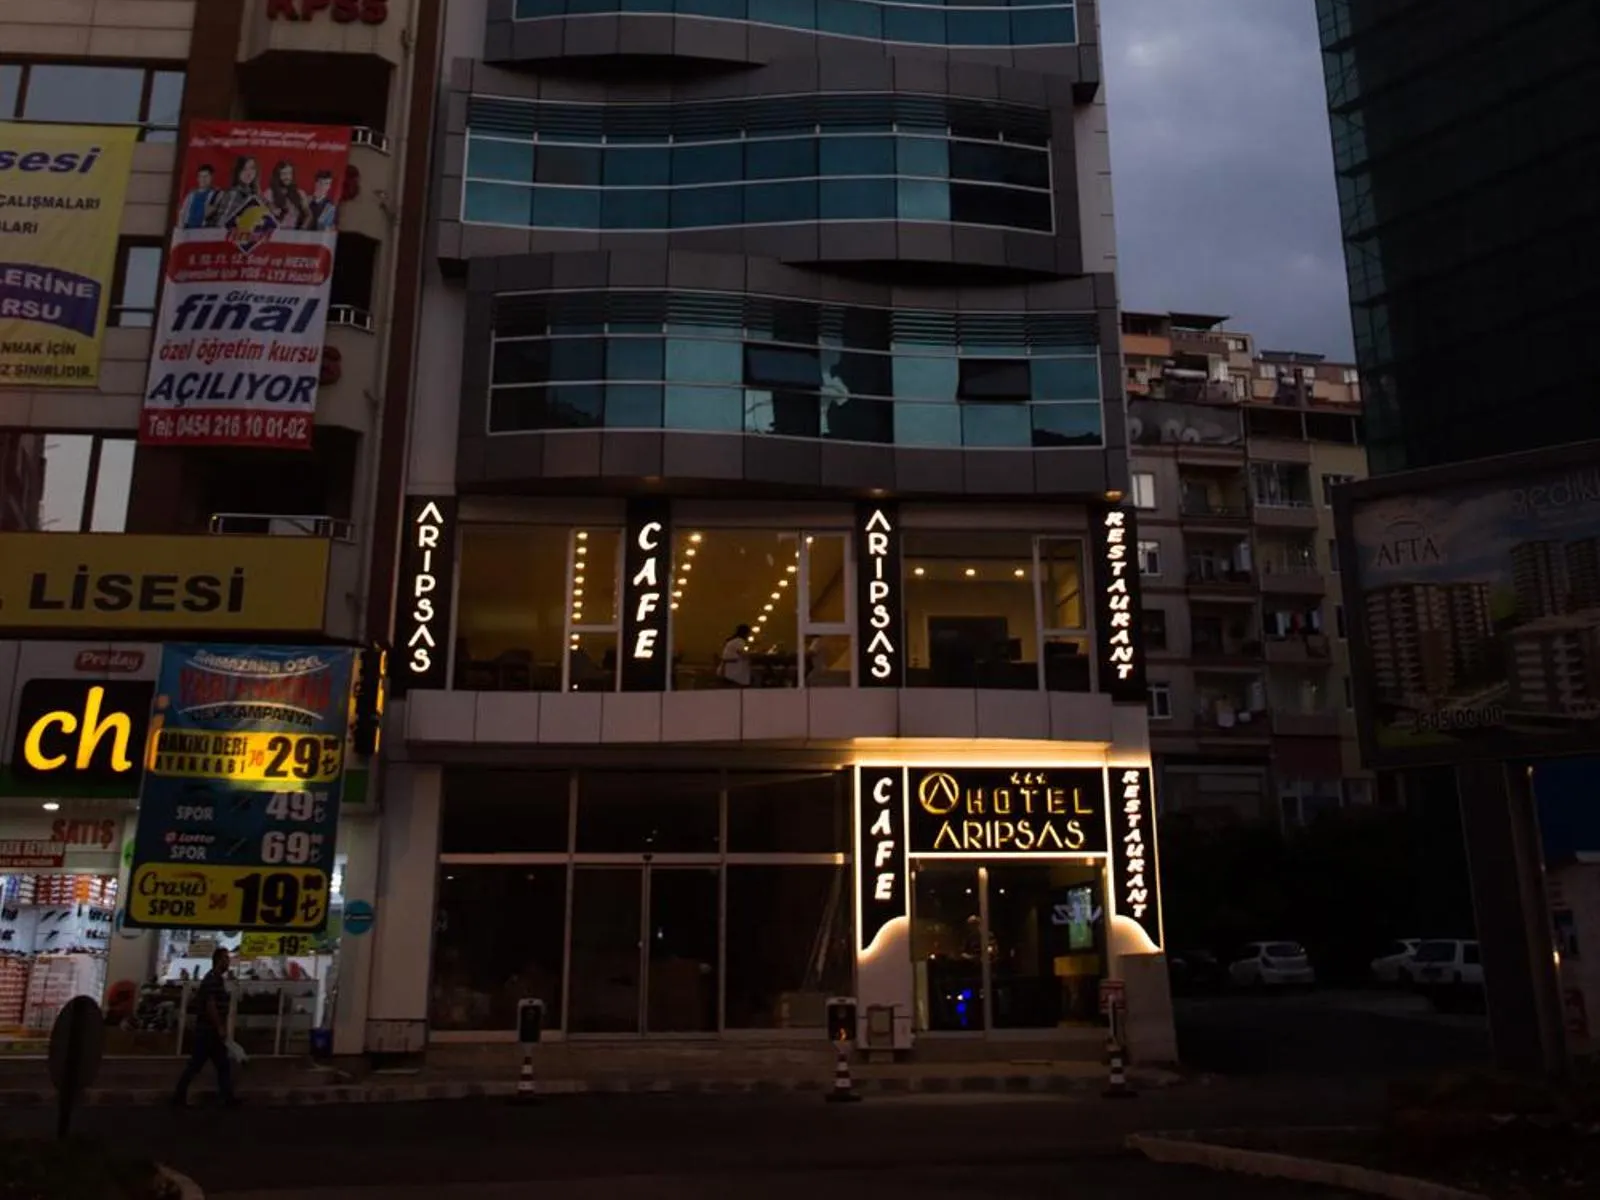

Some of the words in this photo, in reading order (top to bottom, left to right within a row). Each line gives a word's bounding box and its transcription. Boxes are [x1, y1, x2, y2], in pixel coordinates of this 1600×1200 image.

[171, 294, 320, 334] final
[160, 339, 196, 362] özel
[197, 338, 264, 365] öğretim
[268, 340, 318, 363] kursu
[149, 372, 317, 408] AÇILIYOR
[176, 414, 210, 438] 0454
[29, 565, 244, 613] LİSESİ
[408, 502, 444, 672] ARIPSAS
[633, 522, 662, 658] CAFE
[865, 509, 894, 678] ARIPSAS
[1104, 511, 1133, 679] RESTAURANT
[264, 736, 320, 779] 29
[176, 805, 215, 821] SPOR
[266, 792, 313, 821] 49
[966, 787, 1094, 814] HOTEL
[169, 846, 207, 860] SPOR
[260, 831, 310, 864] 69
[870, 777, 895, 900] CAFE
[933, 820, 1085, 850] ARIPSAS
[1122, 770, 1148, 918] RESTAURANT
[148, 899, 196, 916] SPOR
[235, 873, 299, 924] 19
